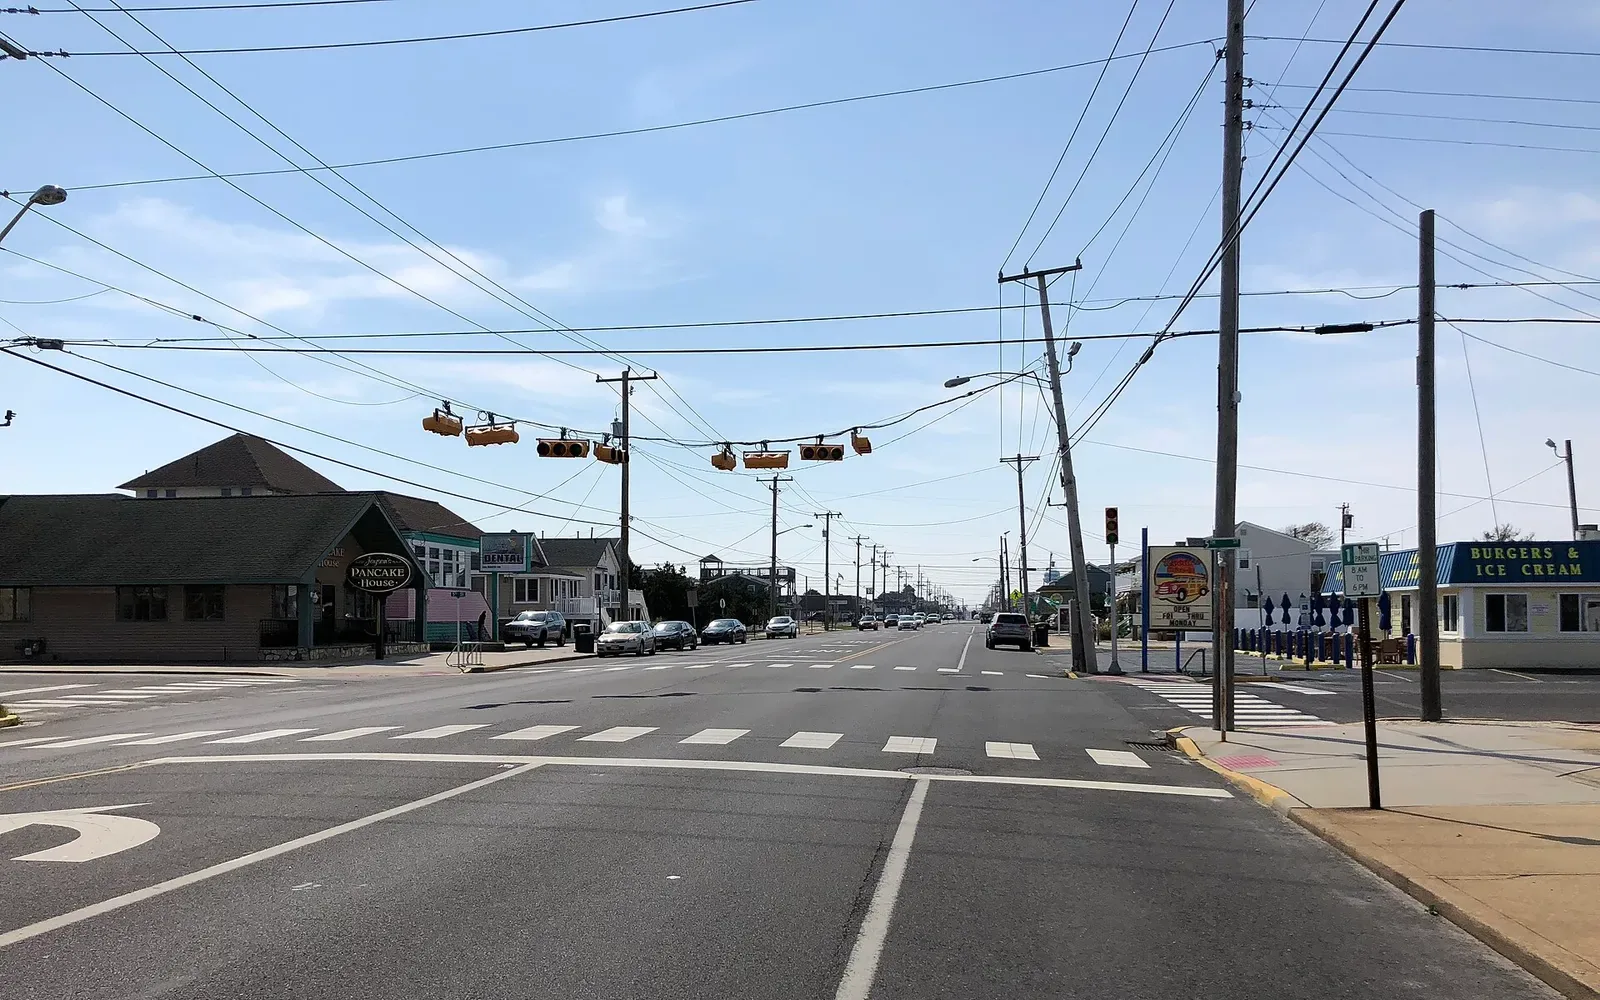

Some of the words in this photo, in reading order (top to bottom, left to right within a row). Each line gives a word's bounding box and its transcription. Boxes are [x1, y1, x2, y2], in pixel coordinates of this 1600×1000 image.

[483, 553, 522, 564] DENTAL
[1346, 548, 1351, 563] 1
[1355, 554, 1377, 562] PARKING
[1471, 547, 1553, 559] BURGERS
[1568, 547, 1579, 559] &
[351, 567, 405, 577] PANCAKE
[1476, 564, 1507, 576] ICE
[1521, 563, 1582, 576] CREAM
[361, 579, 395, 587] House
